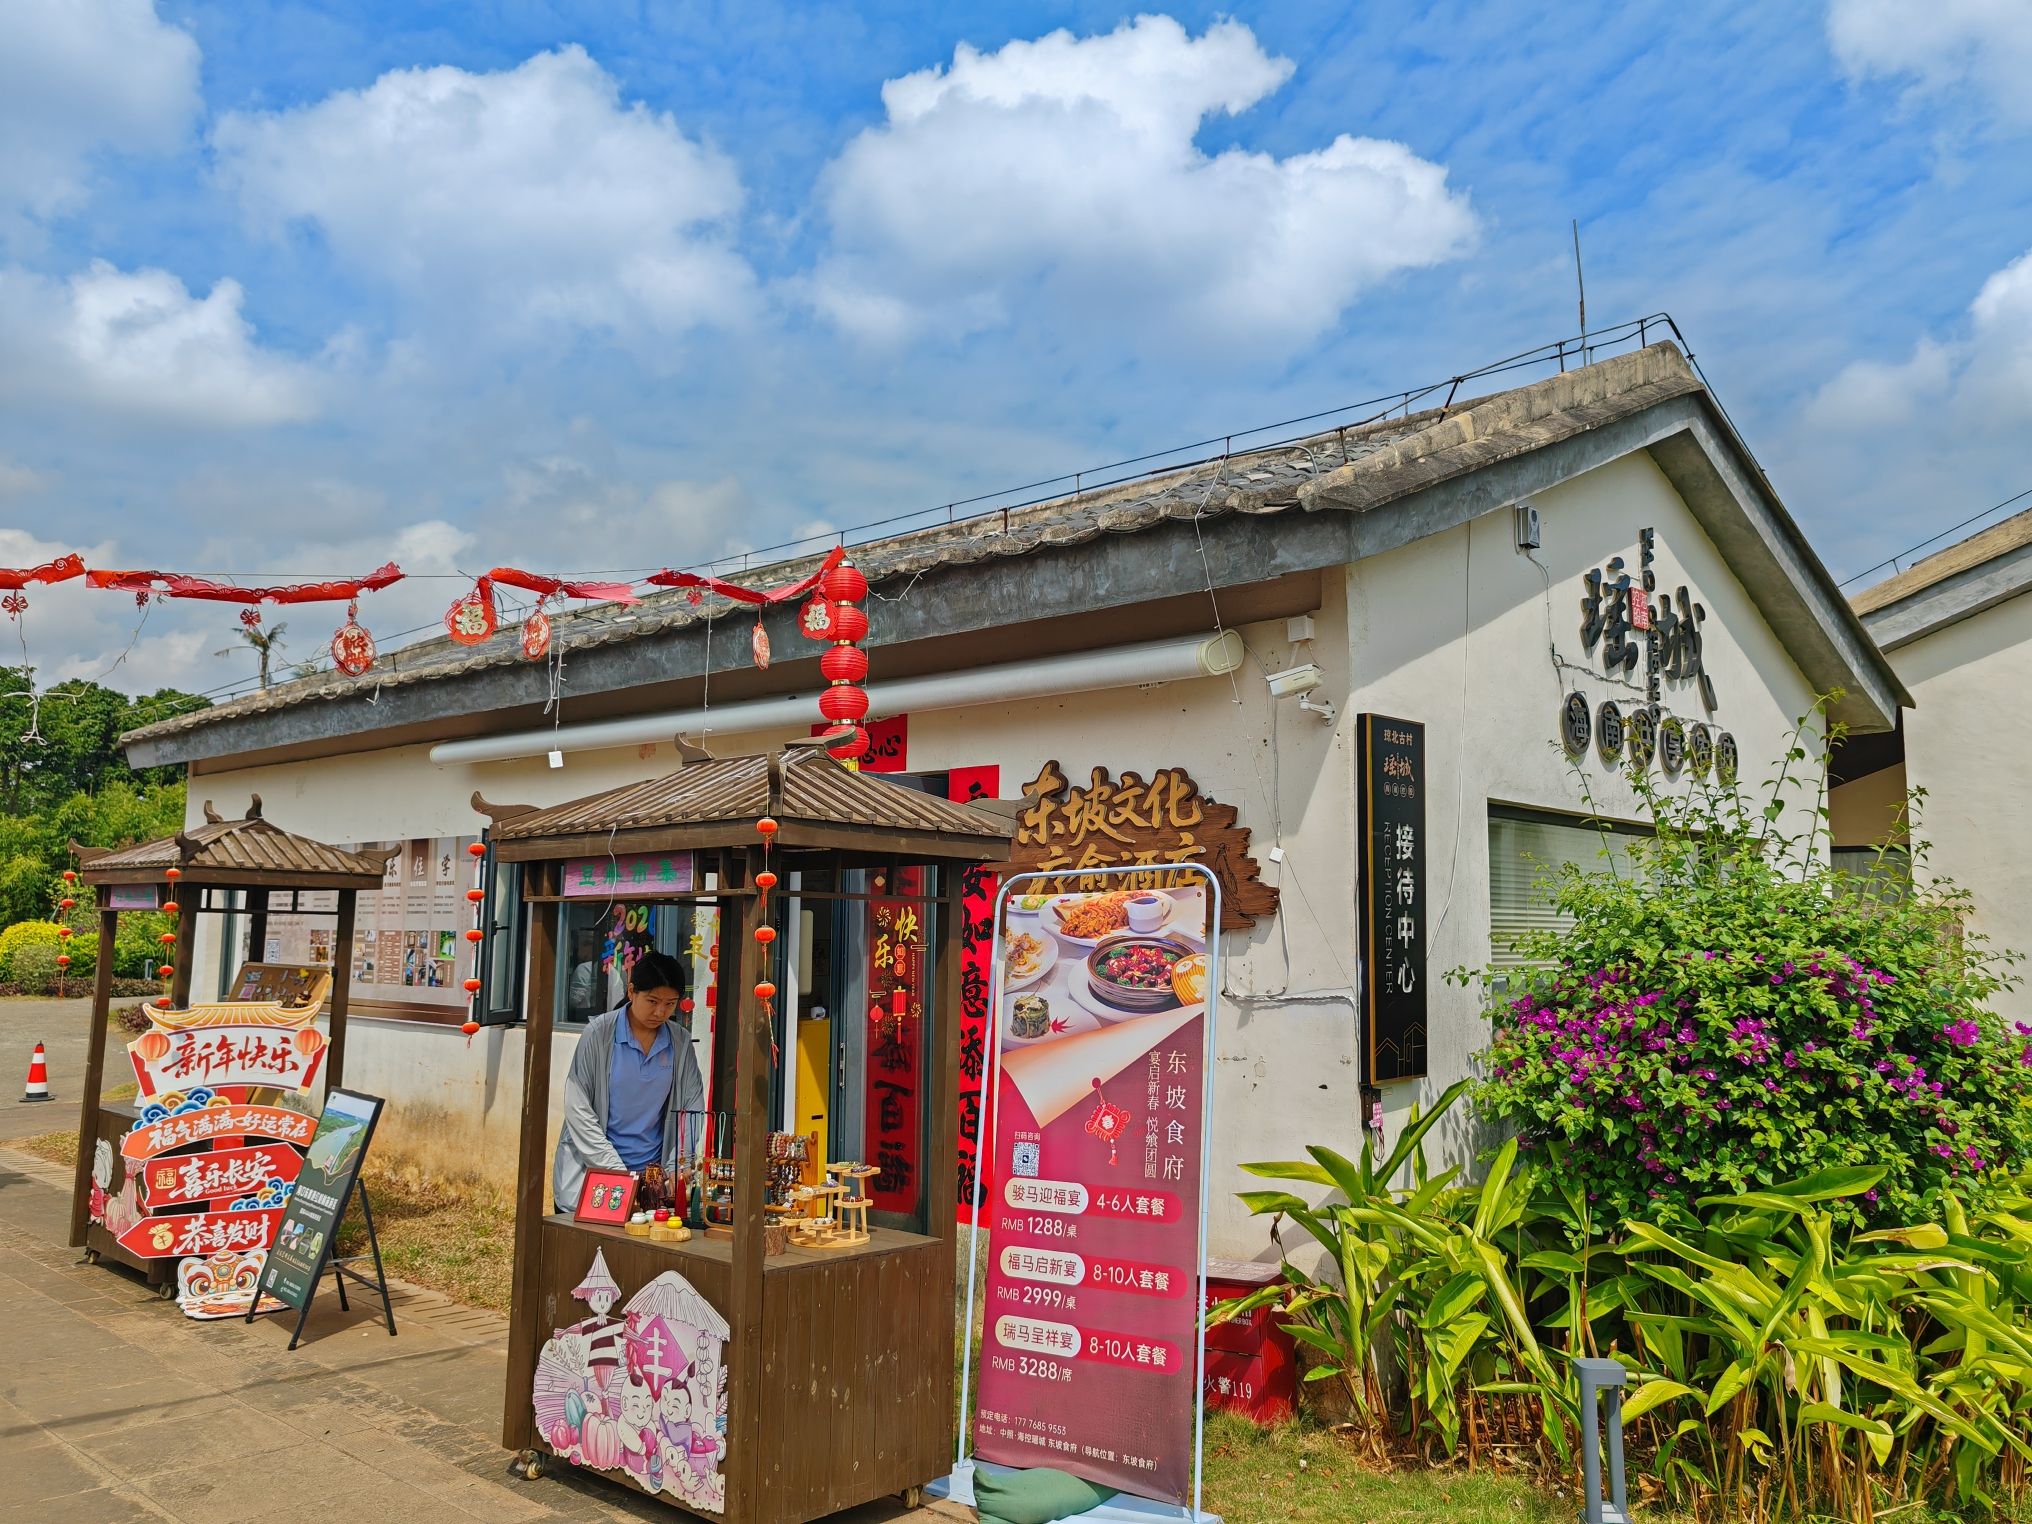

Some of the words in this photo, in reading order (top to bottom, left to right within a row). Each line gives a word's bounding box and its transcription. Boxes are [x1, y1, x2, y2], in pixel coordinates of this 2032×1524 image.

[455, 603, 488, 636] 福
[1018, 760, 1204, 846] 东坡文化
[1384, 822, 1393, 914] RECEPTION
[1396, 823, 1415, 994] 接待中心
[1384, 918, 1393, 994] CENTER
[161, 1033, 300, 1081] 新年快乐
[1147, 1051, 1160, 1111] 宴启新春
[1014, 1131, 1041, 1142] 扫码咨询
[1101, 1114, 1115, 1130] 春
[1163, 1050, 1187, 1181] 东坡食府
[169, 1151, 277, 1199] 喜乐长安
[1012, 1184, 1081, 1208] 骏马迎福宴
[1096, 1193, 1165, 1217] 4-6人套餐
[172, 1213, 271, 1255] 恭喜发财
[1001, 1217, 1024, 1231] RMB
[1027, 1216, 1078, 1239] 1288/桌
[1007, 1252, 1077, 1278] 福马启新宴
[1093, 1264, 1170, 1292] 8-10人套餐
[997, 1286, 1020, 1301] RMB
[1022, 1286, 1077, 1310] 2999/桌
[643, 1328, 673, 1391] 丰
[1003, 1322, 1074, 1350] 瑞马呈祥宴
[1089, 1337, 1168, 1367] 8-10人套餐
[992, 1355, 1015, 1371] RMB
[1019, 1356, 1073, 1382] 3288/席
[1014, 1416, 1026, 1427] 177
[1029, 1419, 1046, 1432] 7685
[1048, 1423, 1066, 1436] 9553
[1048, 1438, 1078, 1454] 东坡食府
